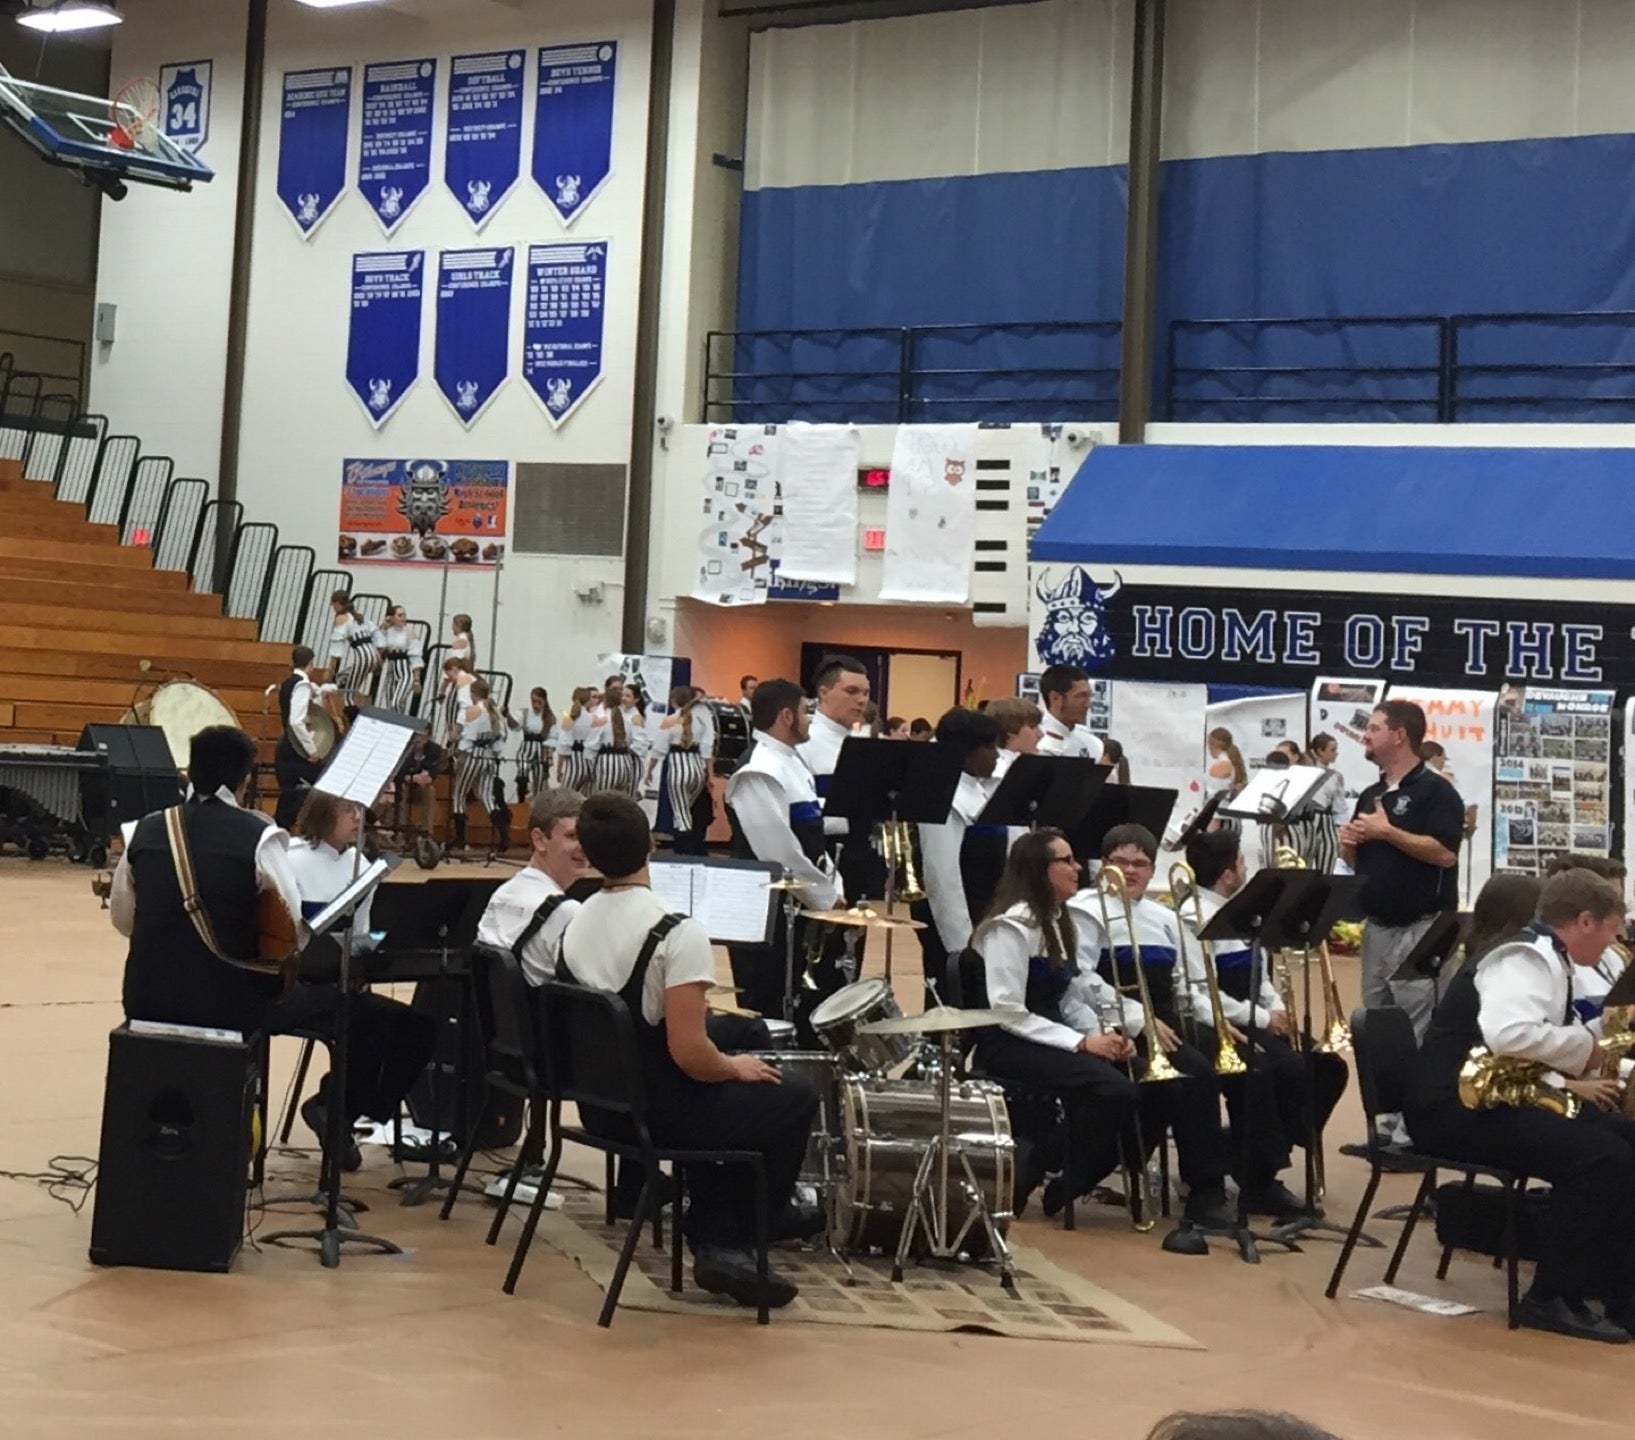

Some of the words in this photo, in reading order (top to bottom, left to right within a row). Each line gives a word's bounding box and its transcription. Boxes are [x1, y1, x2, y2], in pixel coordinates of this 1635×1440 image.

[169, 101, 196, 130] 34
[473, 270, 501, 280] TRACK
[537, 266, 568, 276] WINTER
[385, 273, 410, 282] TRACK
[1131, 605, 1321, 665] HOME
[1343, 613, 1430, 671] OF
[1453, 618, 1602, 681] THE
